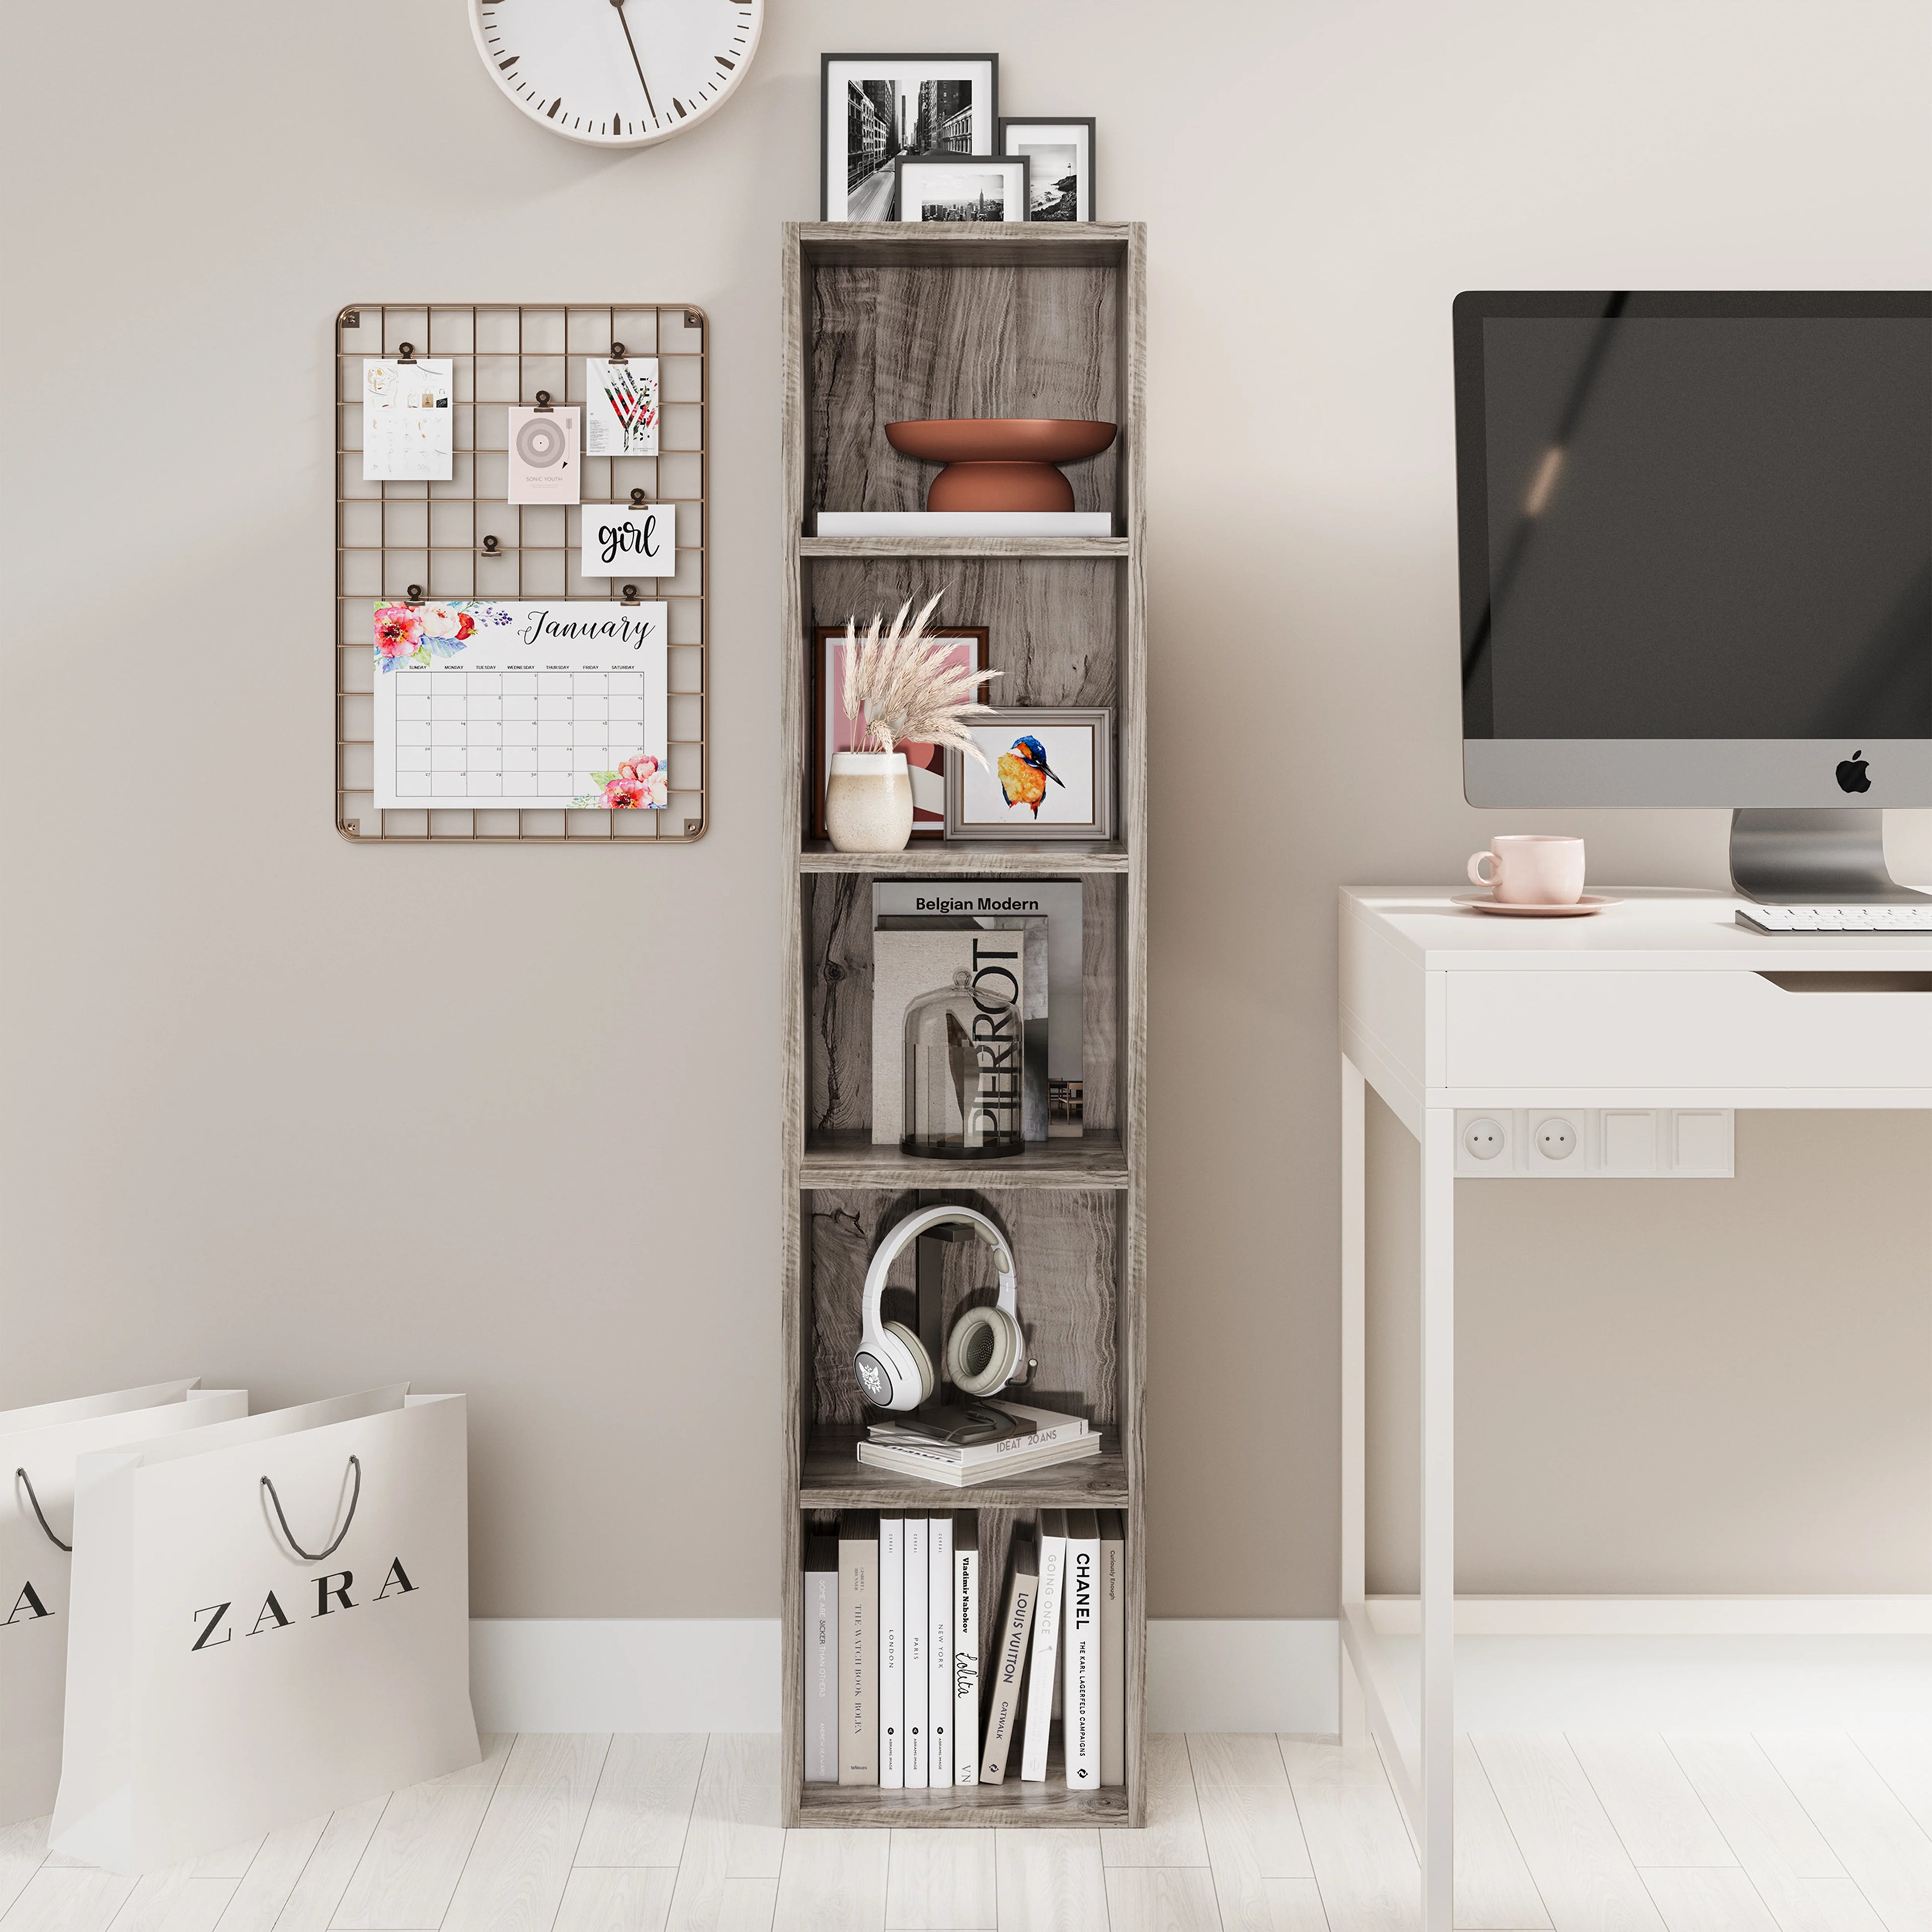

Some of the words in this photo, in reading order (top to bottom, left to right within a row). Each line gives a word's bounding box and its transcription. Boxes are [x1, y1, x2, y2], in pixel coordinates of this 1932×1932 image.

[598, 515, 660, 564] girl
[517, 610, 656, 650] January
[916, 897, 973, 914] Belgian
[978, 897, 1038, 910] Modern
[997, 1438, 1021, 1453] IDEAT
[1045, 1555, 1057, 1595] GOING
[1076, 1553, 1090, 1630] CHANEL
[191, 1557, 420, 1651] ZARA
[1013, 1592, 1029, 1629] LOUIS
[1041, 1601, 1053, 1635] ONCE
[955, 1652, 979, 1699] Lolita
[1003, 1632, 1022, 1683] VUITTON
[996, 1702, 1009, 1740] CATWALK
